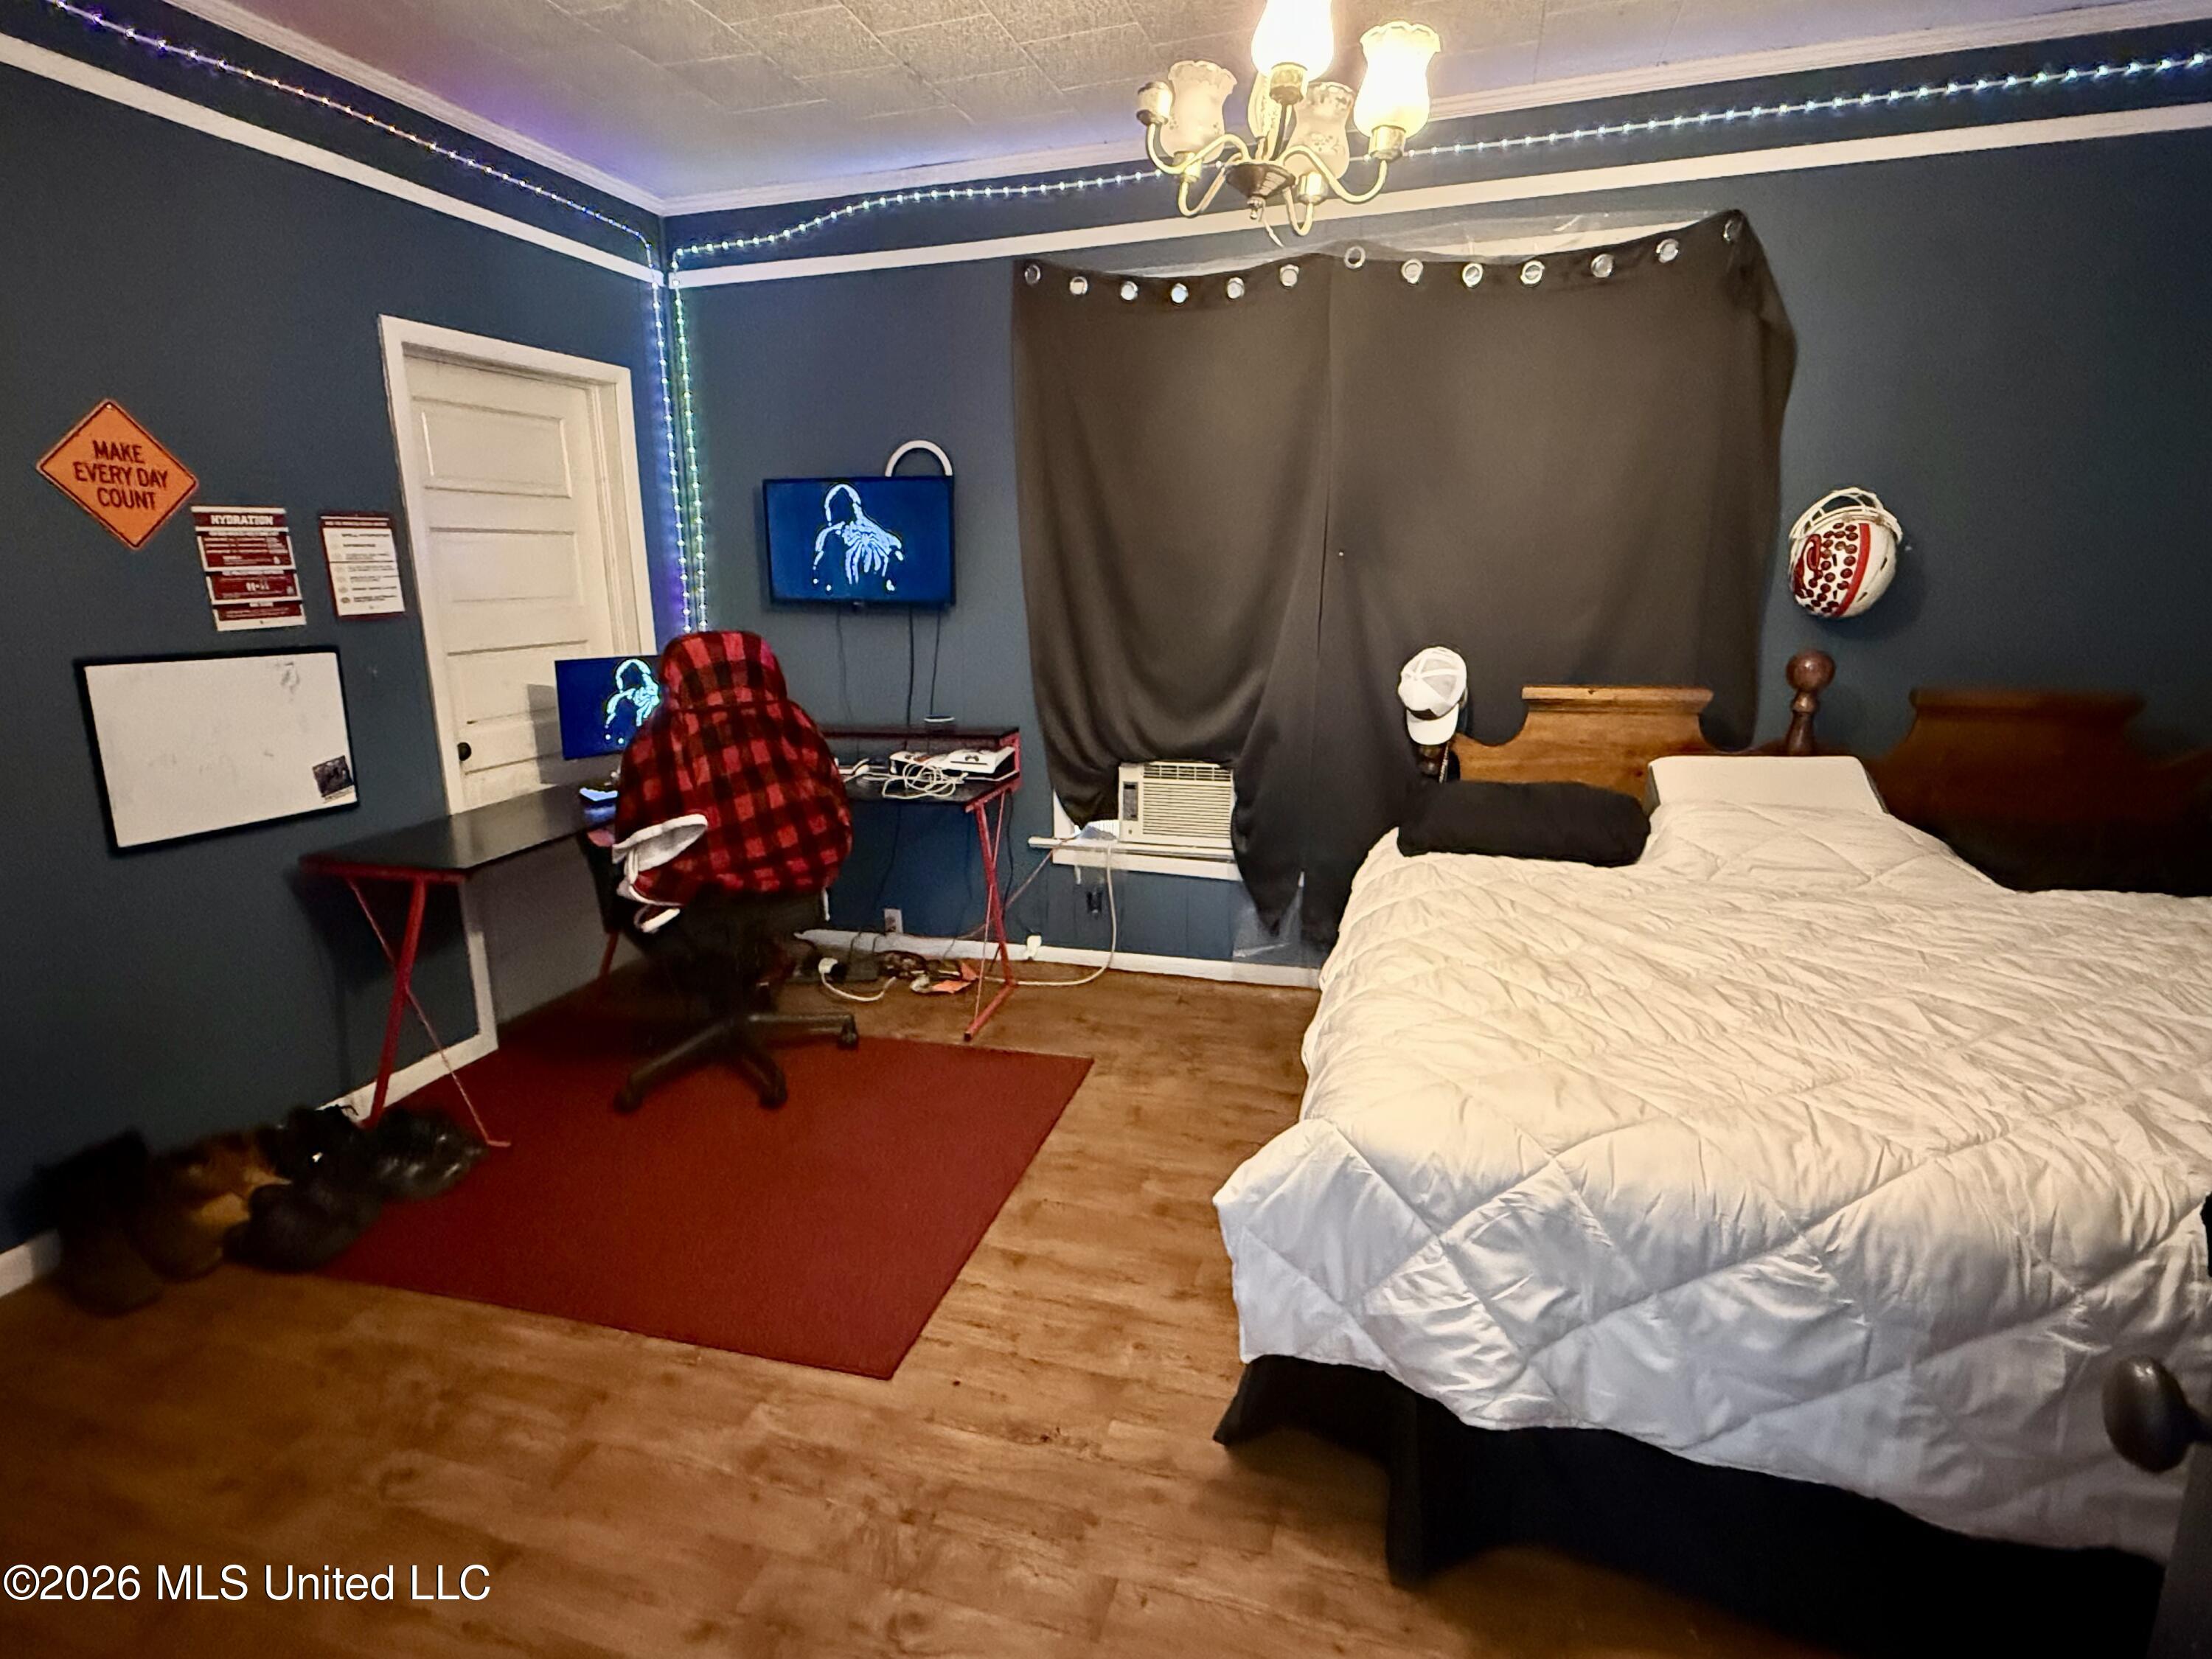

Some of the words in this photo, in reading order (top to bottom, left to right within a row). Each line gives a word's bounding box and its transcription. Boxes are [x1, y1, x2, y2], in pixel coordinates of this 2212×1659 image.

[93, 440, 145, 464] MAKE
[73, 462, 132, 486] EVERY
[136, 467, 168, 489] DAY
[97, 487, 156, 510] COUNT
[210, 515, 274, 526] HYDRATION
